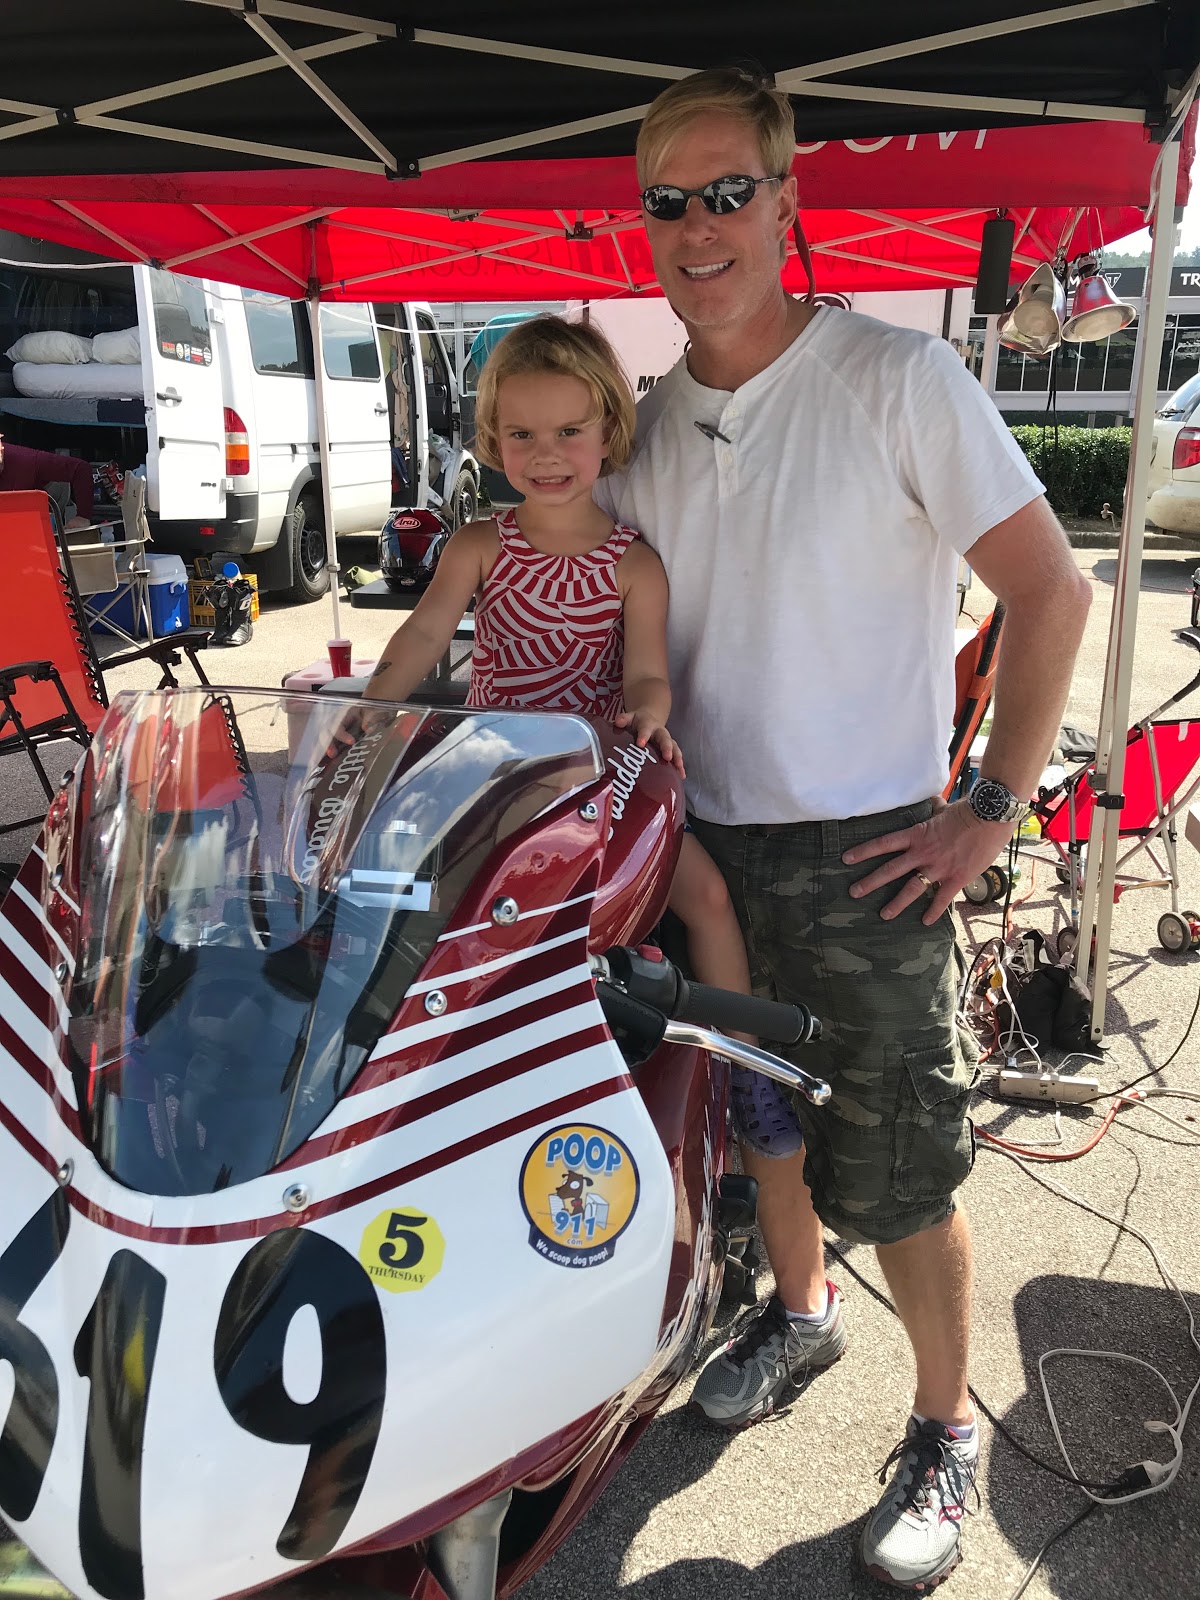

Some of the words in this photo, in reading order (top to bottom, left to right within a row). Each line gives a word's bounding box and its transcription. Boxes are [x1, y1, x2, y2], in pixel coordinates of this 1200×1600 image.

[393, 518, 418, 527] Arai
[328, 731, 383, 791] Little
[546, 1132, 622, 1176] POOP
[555, 1210, 597, 1240] 911
[378, 1212, 428, 1270] 5
[535, 1239, 548, 1254] We
[548, 1250, 571, 1266] scoop
[572, 1255, 587, 1267] dog
[588, 1247, 609, 1266] poop!
[368, 1265, 426, 1283] THURSDAY
